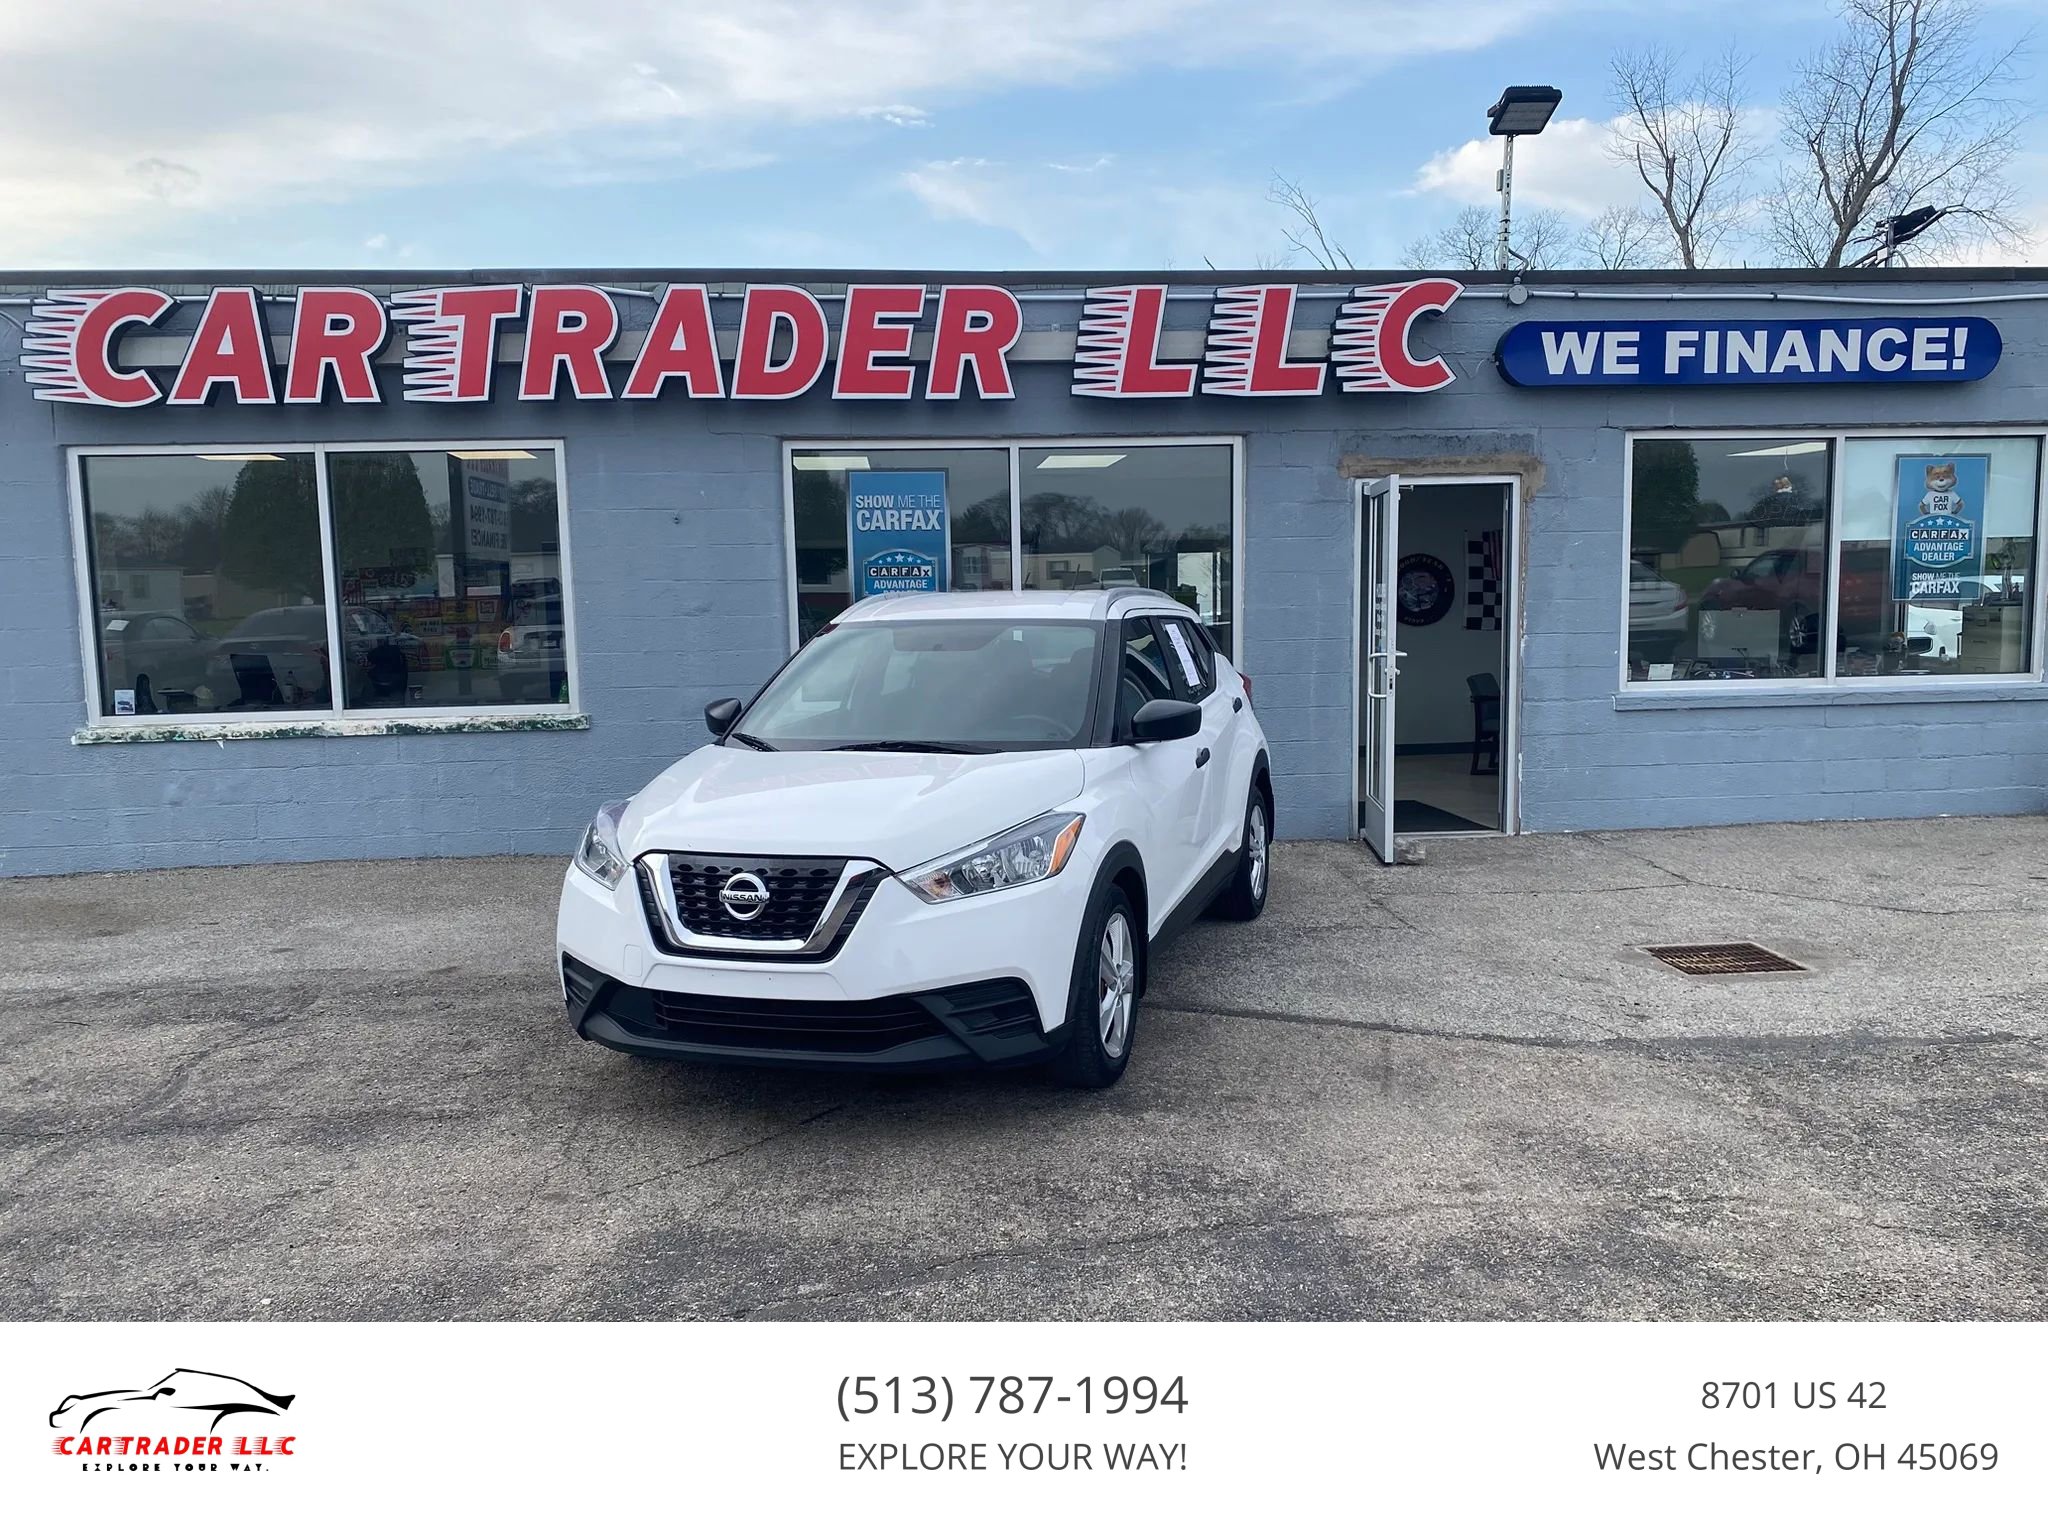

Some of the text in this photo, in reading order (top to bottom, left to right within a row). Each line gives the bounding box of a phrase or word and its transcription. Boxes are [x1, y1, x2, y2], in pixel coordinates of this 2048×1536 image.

[1071, 277, 1466, 398] LLC
[1541, 327, 1969, 376] WE FINANCE!
[855, 494, 941, 509] SHOW ME THE
[1933, 495, 1949, 503] CAR
[1933, 503, 1949, 511] FOX
[856, 509, 942, 532] CARFAX
[1910, 529, 1969, 540] CARFAX
[1913, 541, 1965, 551] ADVANTAGE
[1921, 552, 1955, 562] DEALER
[868, 565, 932, 578] CARFAX
[1911, 572, 1935, 581] SHOW
[873, 579, 928, 589] ADVANTAGE
[1911, 581, 1960, 594] CARFAX
[722, 892, 767, 903] NISSAN
